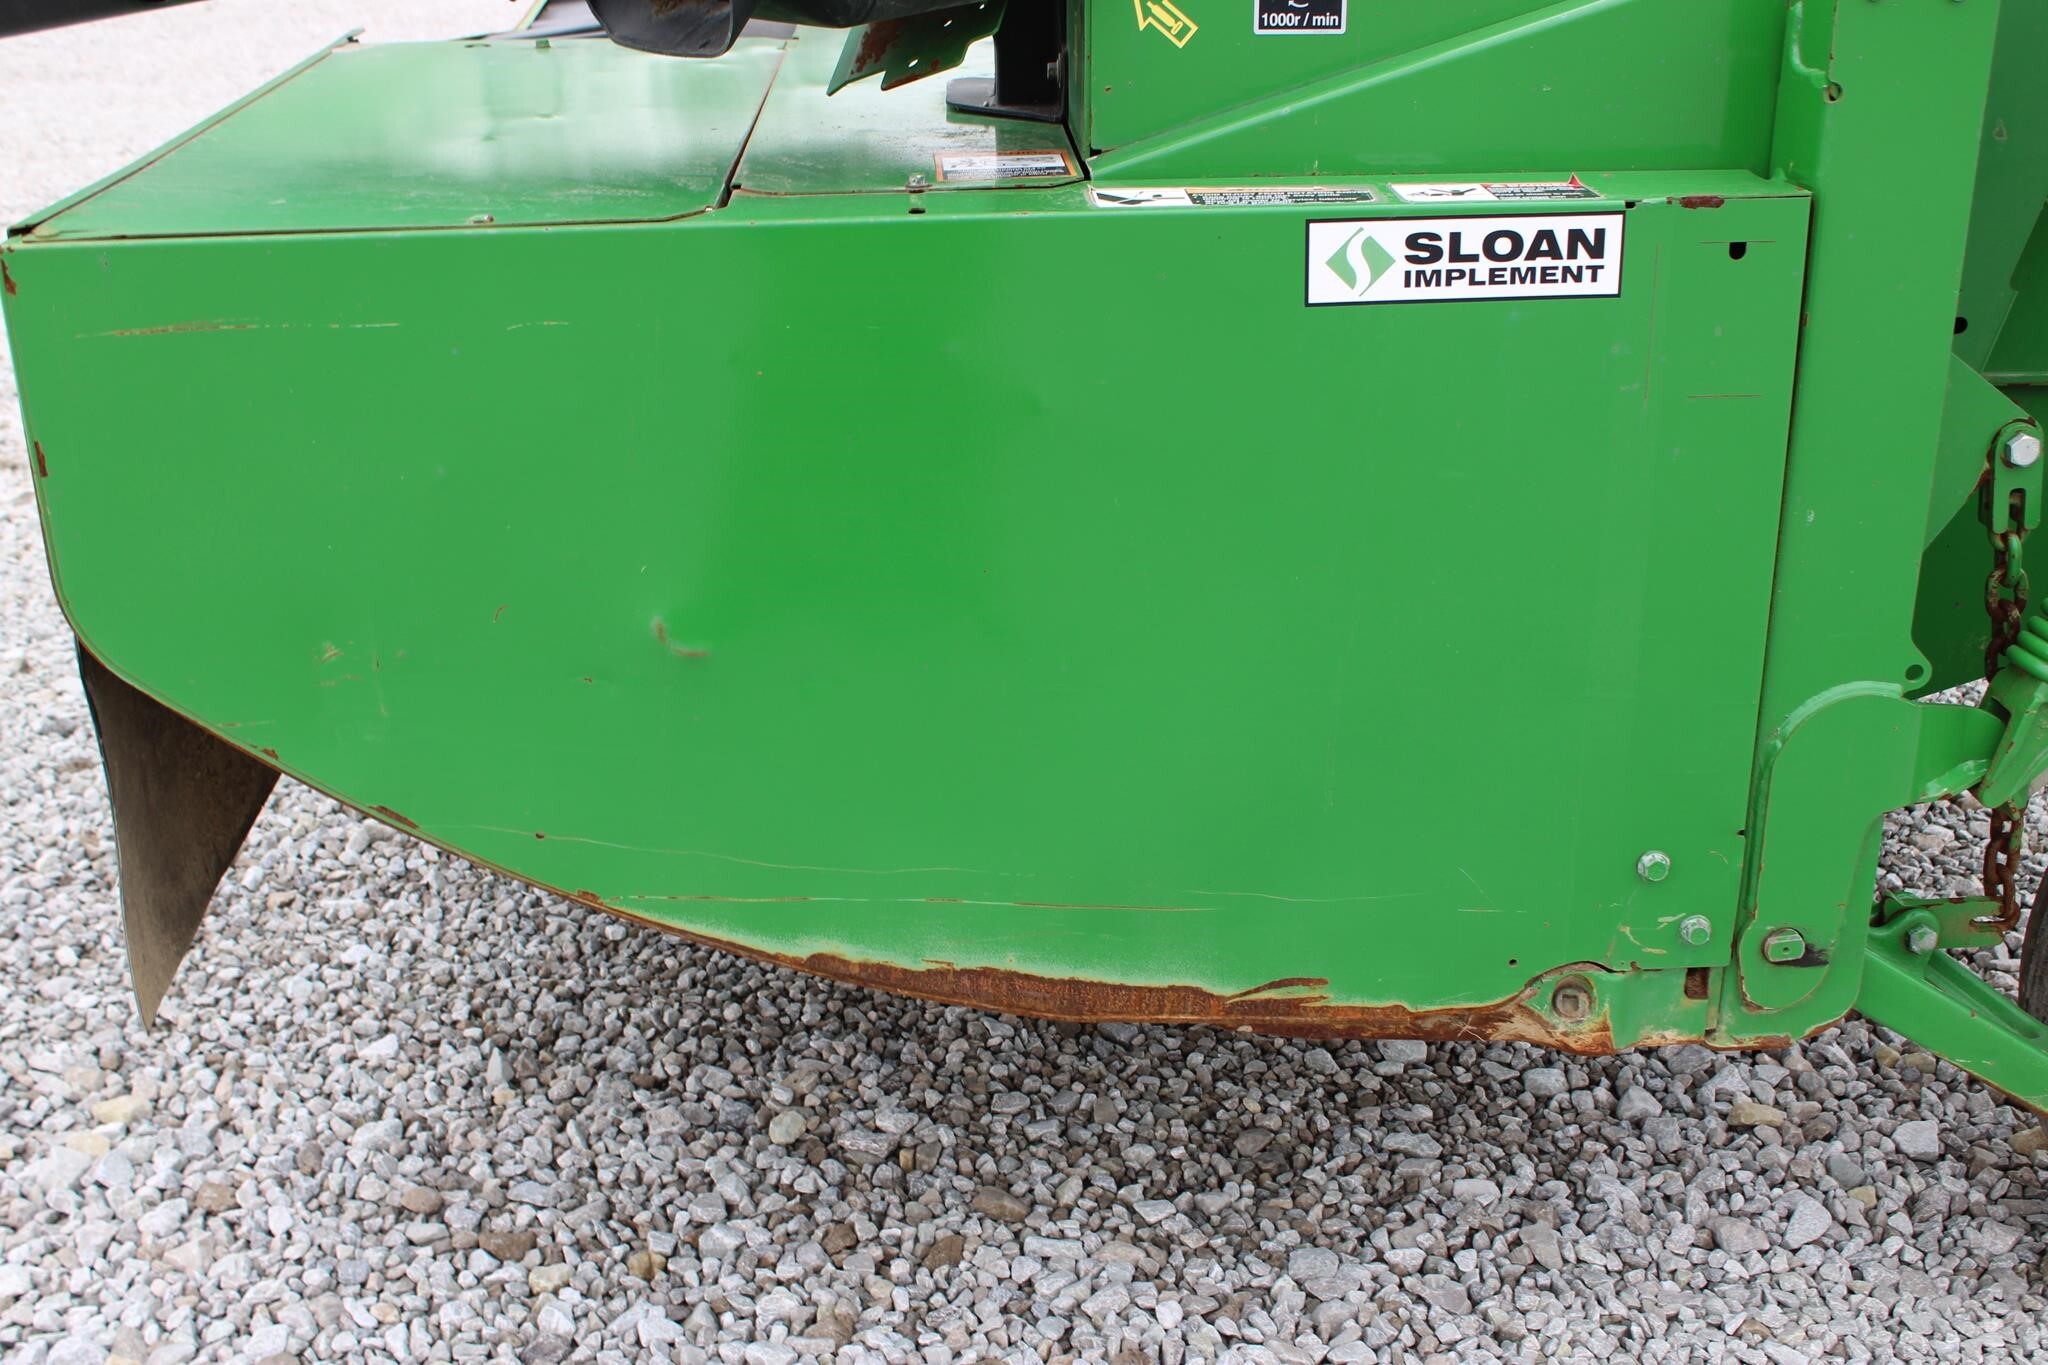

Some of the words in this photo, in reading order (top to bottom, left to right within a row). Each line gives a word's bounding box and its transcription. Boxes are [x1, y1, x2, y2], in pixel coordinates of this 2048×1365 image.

[1262, 13, 1301, 27] 1000r
[1312, 12, 1339, 27] min
[1404, 228, 1606, 265] SLOAN
[1404, 265, 1605, 288] IMPLEMENT
